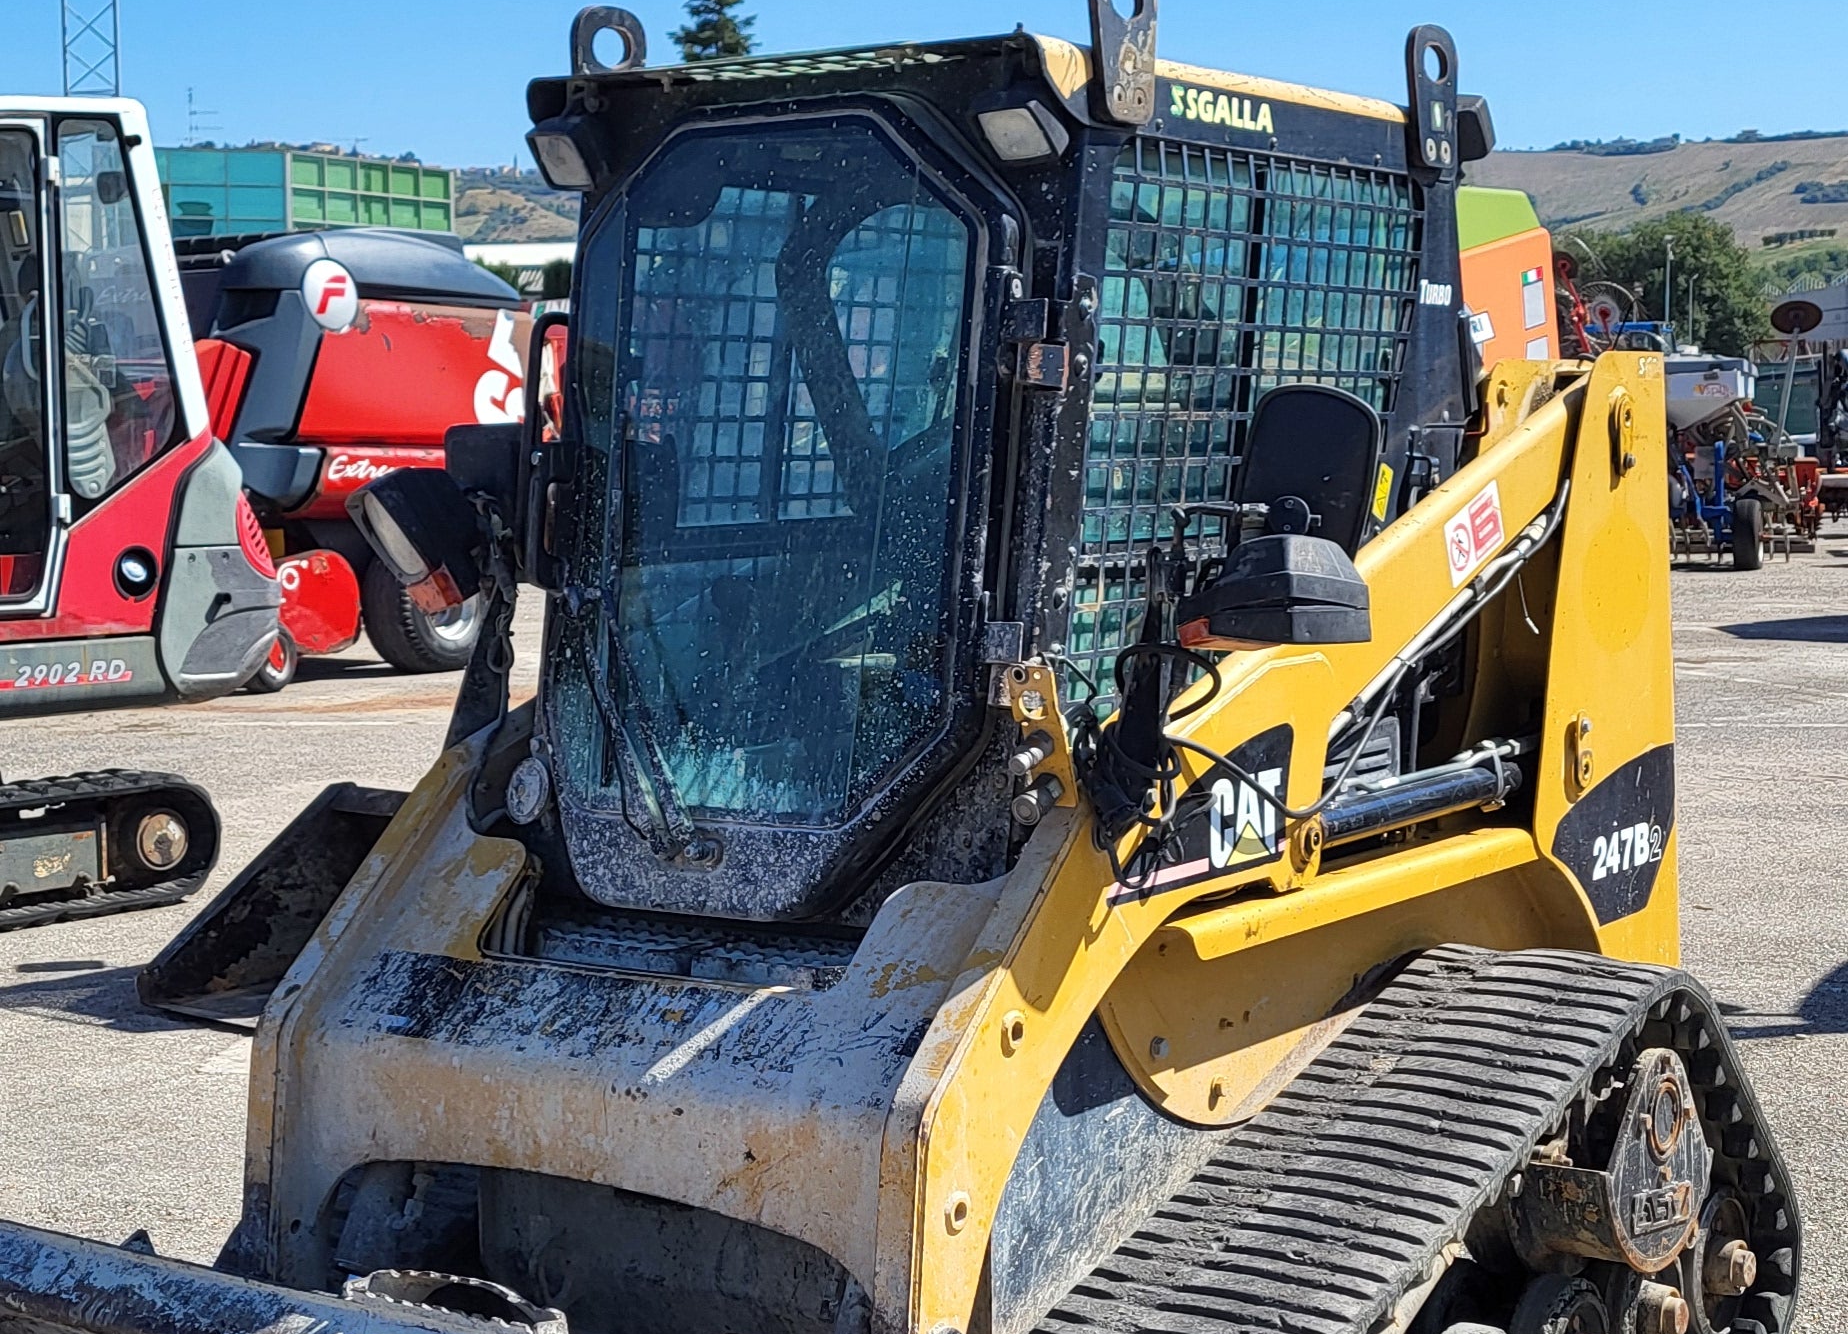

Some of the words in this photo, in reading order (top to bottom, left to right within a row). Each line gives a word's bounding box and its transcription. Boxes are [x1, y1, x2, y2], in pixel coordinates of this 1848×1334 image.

[316, 275, 347, 315] F
[327, 454, 396, 480] Extre
[14, 662, 81, 687] 2902
[89, 659, 127, 681] RD
[1209, 767, 1283, 869] CAT
